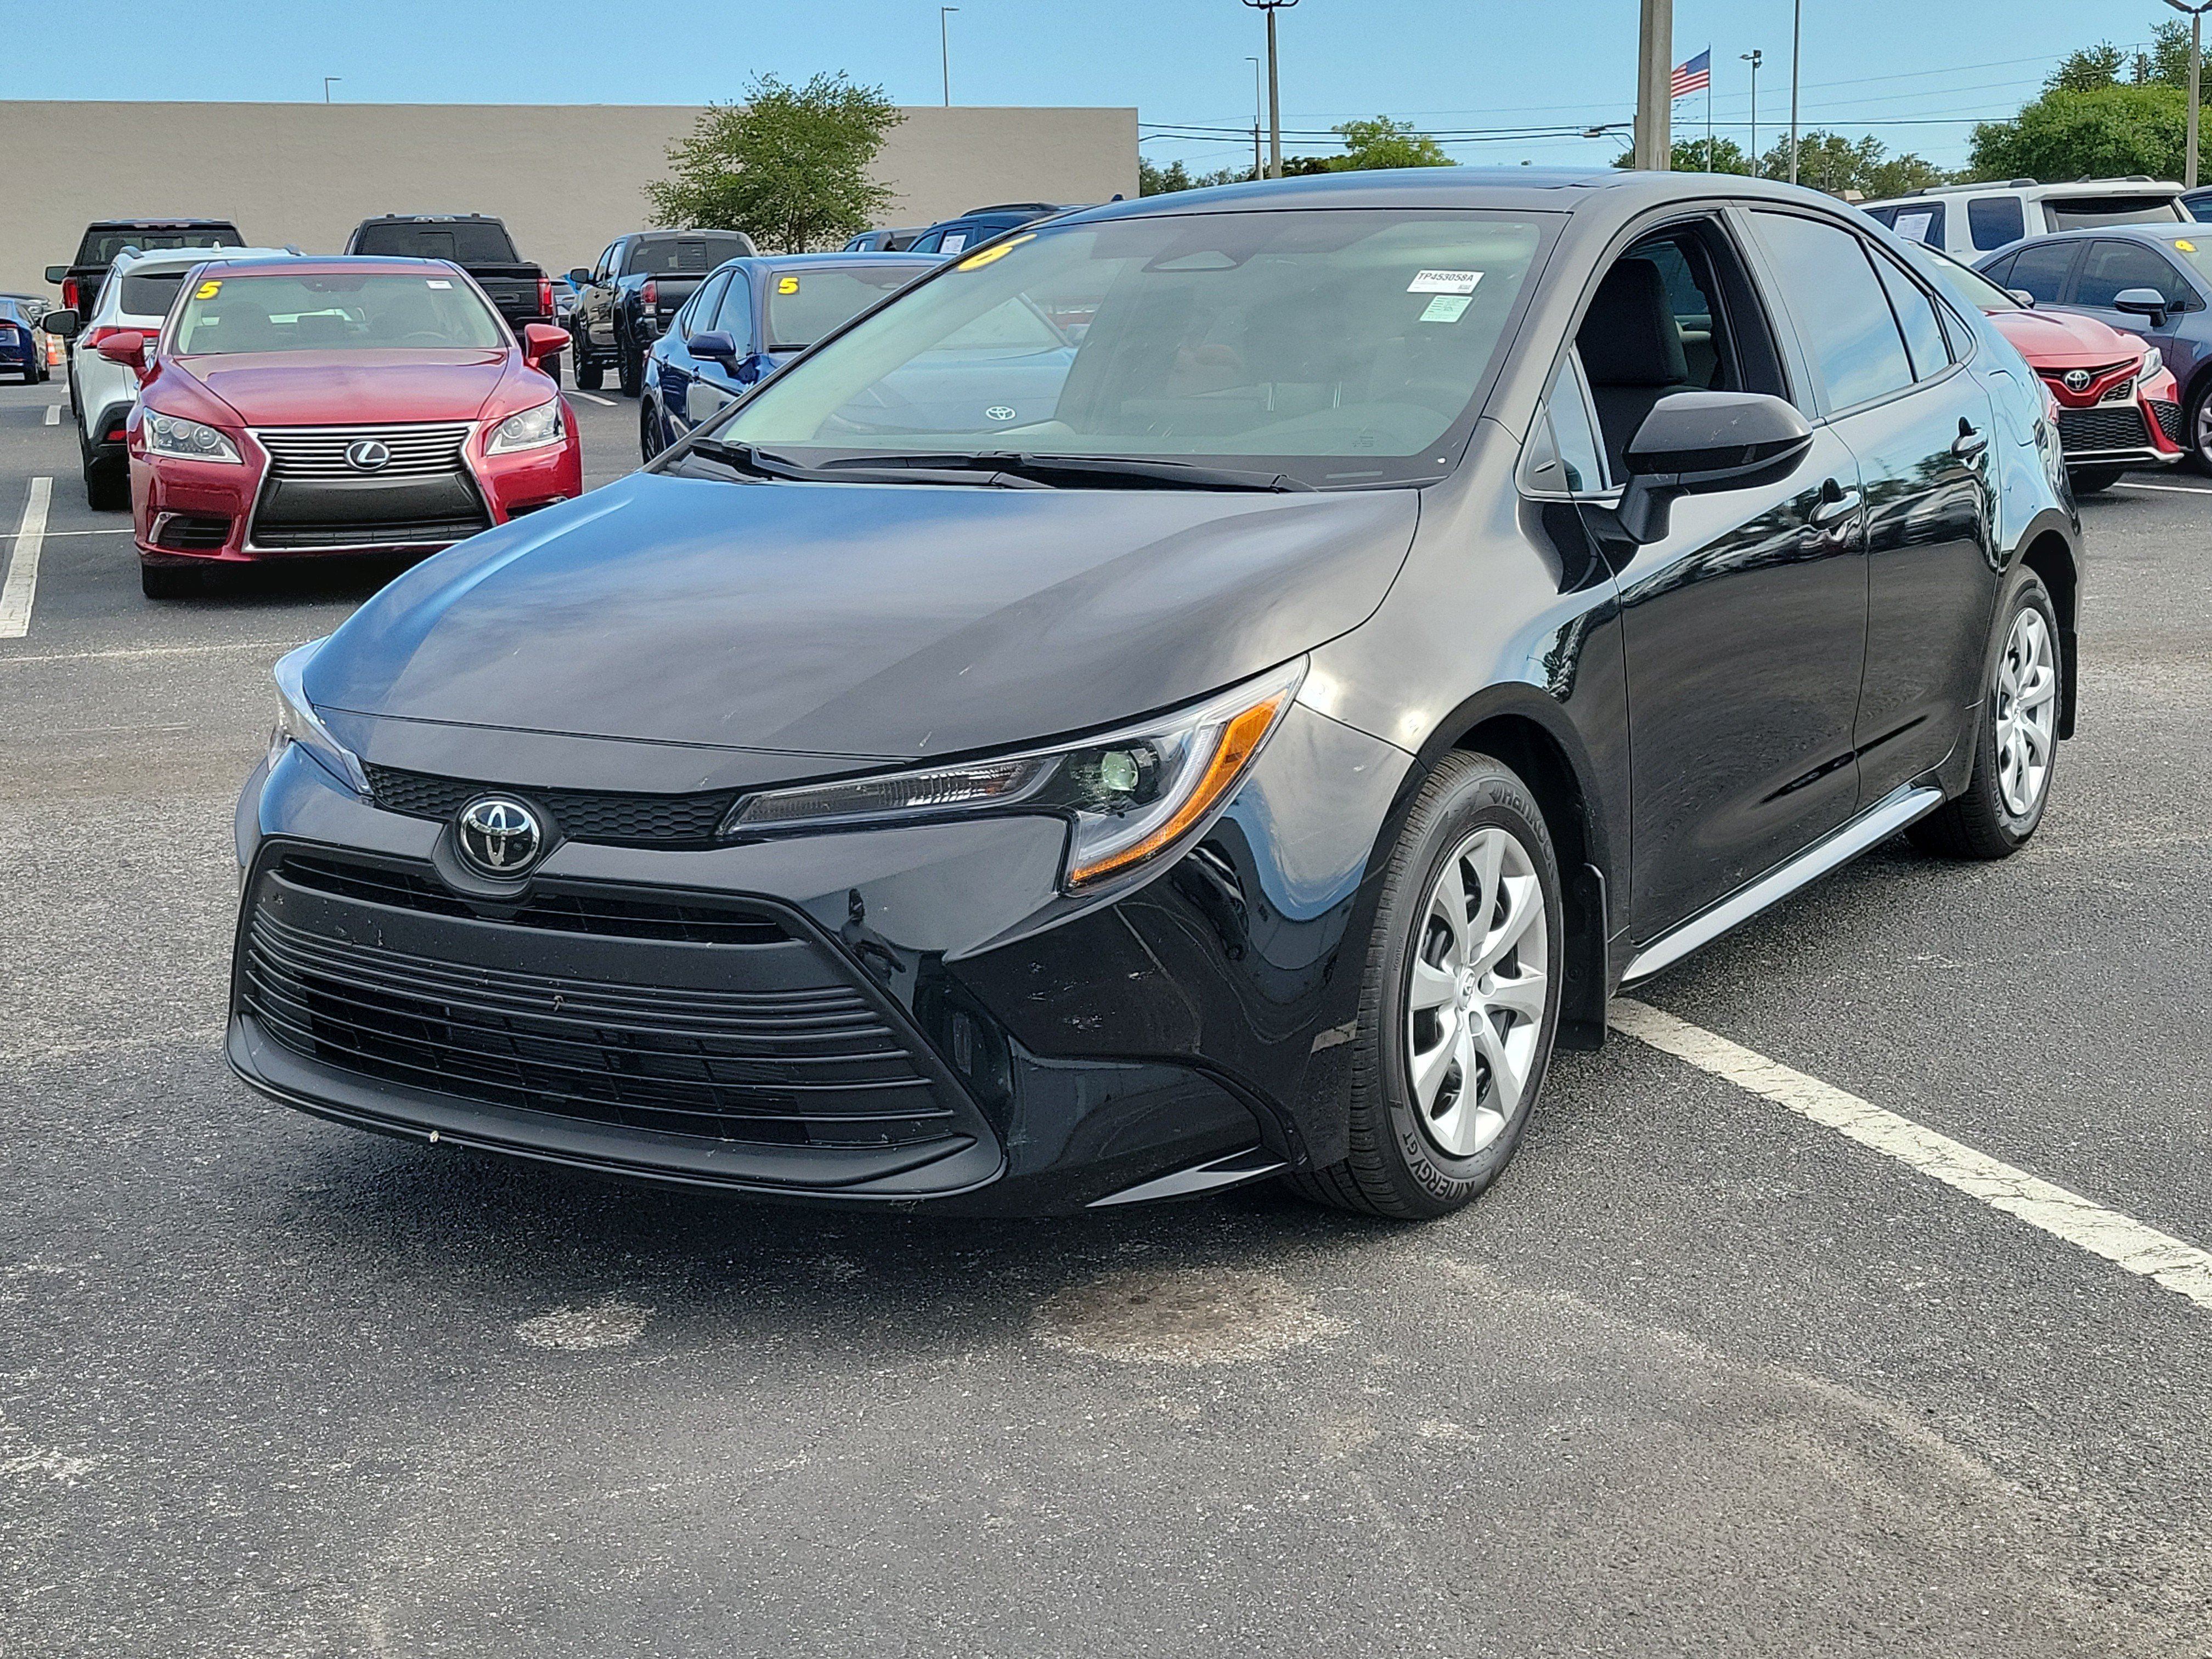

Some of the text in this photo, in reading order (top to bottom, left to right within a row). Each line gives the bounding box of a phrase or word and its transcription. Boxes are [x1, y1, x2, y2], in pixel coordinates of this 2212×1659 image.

[958, 233, 1037, 271] 6
[778, 278, 798, 294] 5
[1418, 273, 1474, 281] TP453058A
[196, 281, 222, 299] 5
[1402, 1131, 1418, 1155] GT
